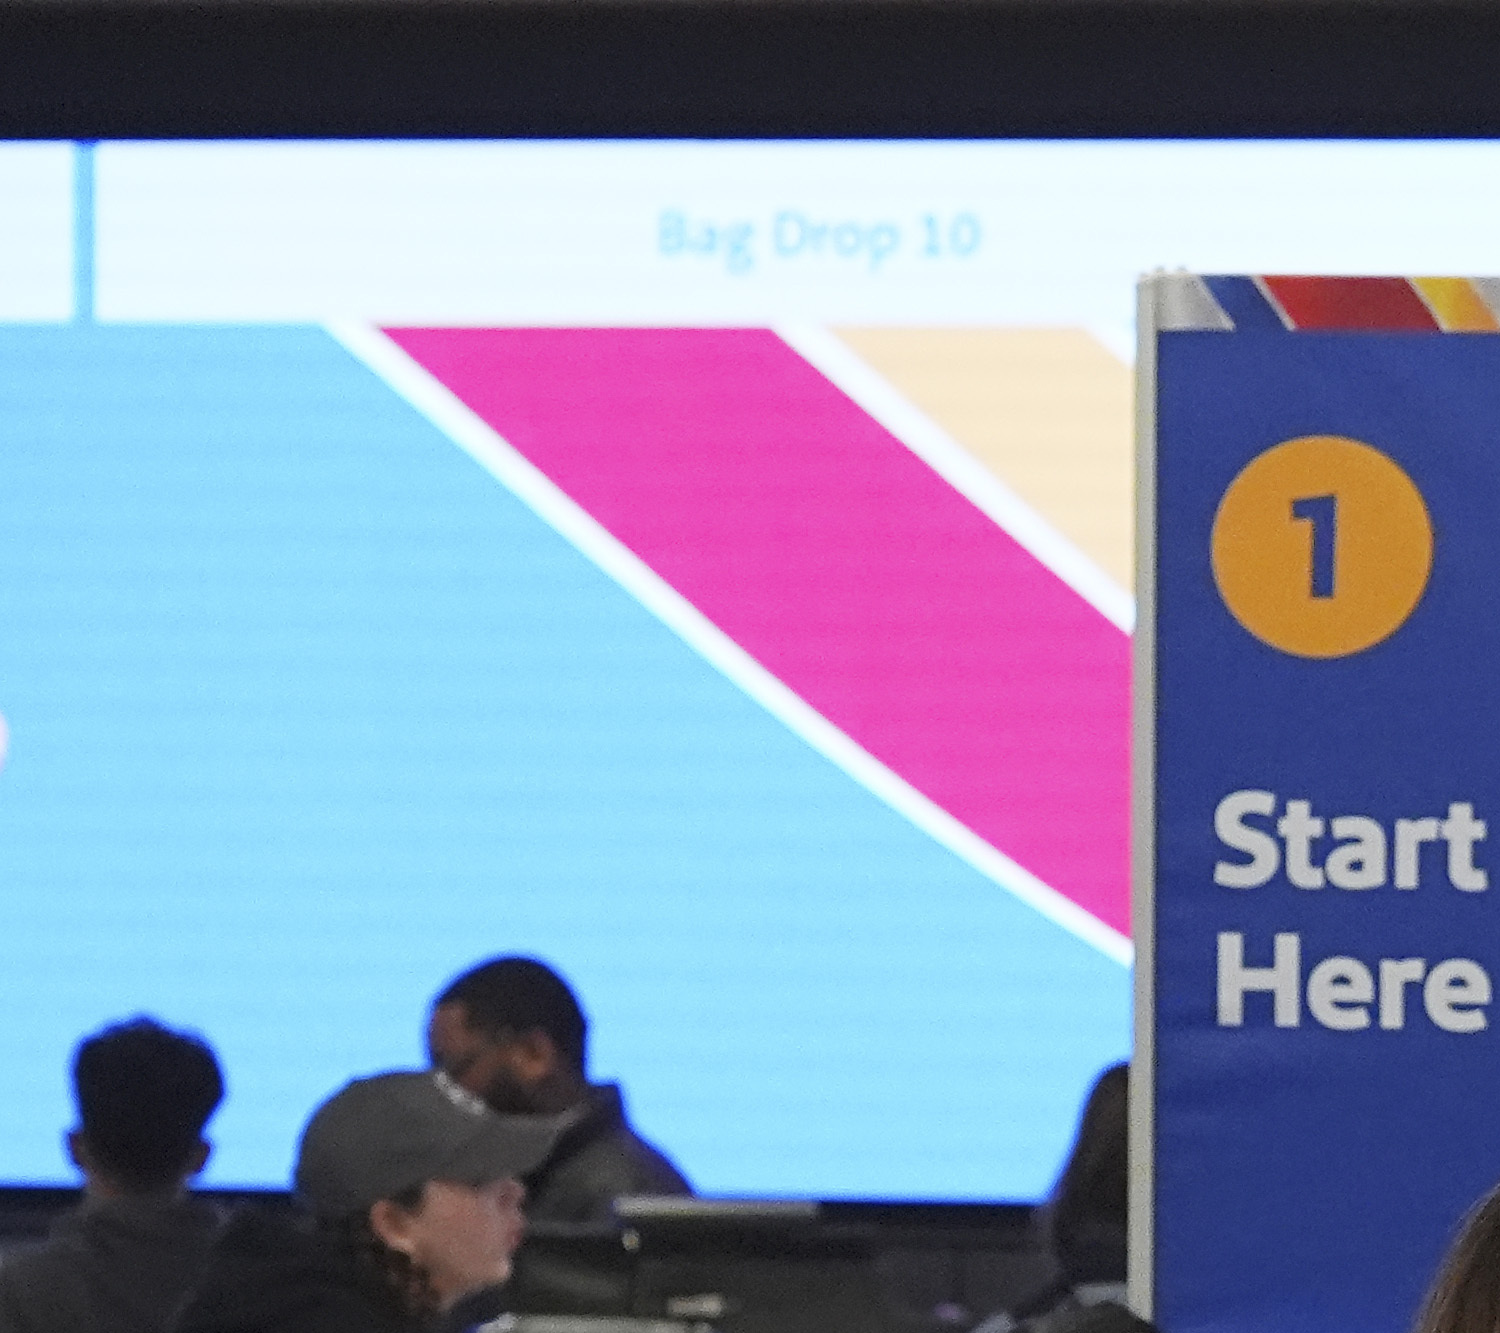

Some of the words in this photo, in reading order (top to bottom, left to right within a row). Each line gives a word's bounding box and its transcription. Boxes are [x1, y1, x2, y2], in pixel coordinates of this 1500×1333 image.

[657, 208, 757, 276] Bag
[770, 208, 903, 273] Drop
[919, 210, 985, 259] 10
[1289, 493, 1338, 600] 1
[1213, 789, 1489, 893] Start
[1216, 930, 1493, 1034] Here
